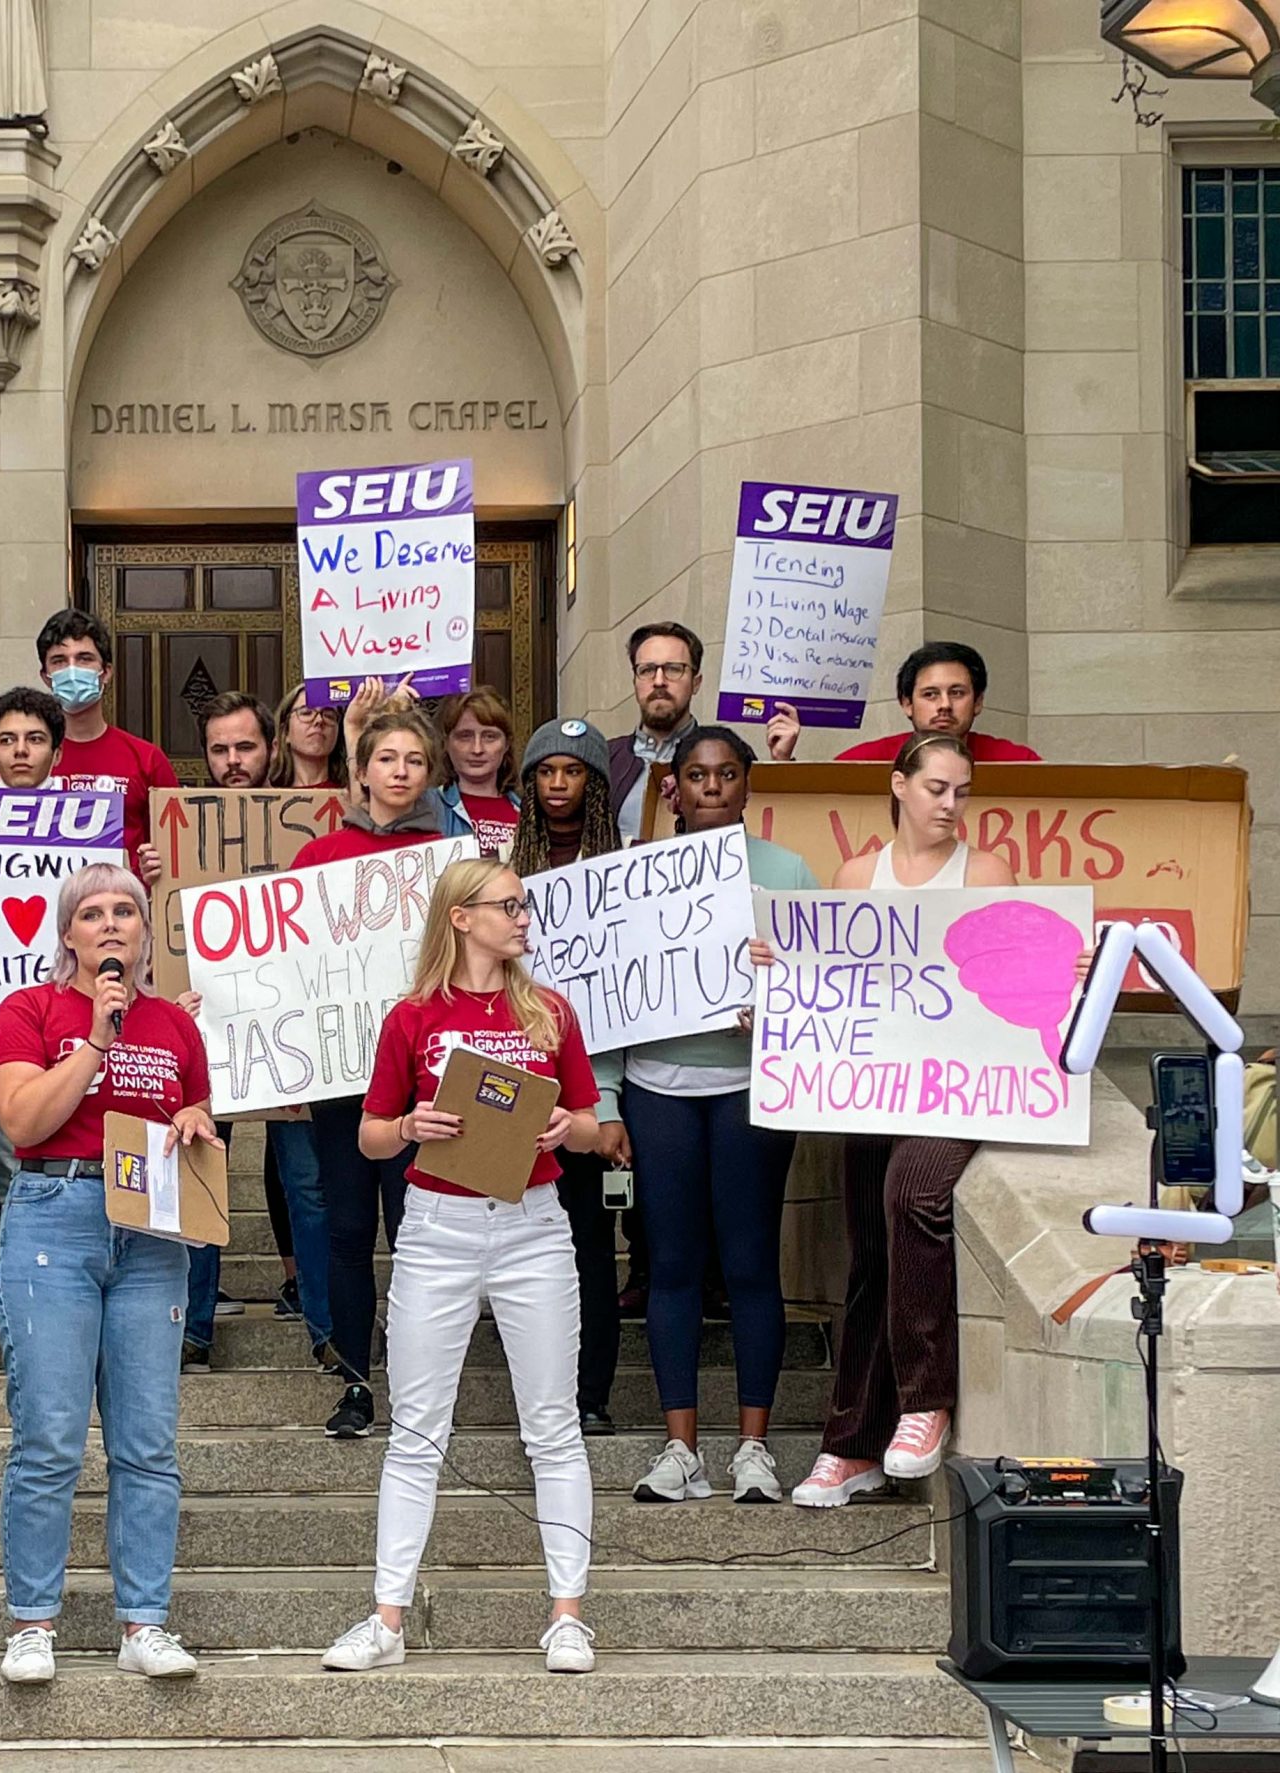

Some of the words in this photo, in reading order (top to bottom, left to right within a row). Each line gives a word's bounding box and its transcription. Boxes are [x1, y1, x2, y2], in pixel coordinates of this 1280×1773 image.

[90, 402, 216, 434] DANIEL
[230, 402, 258, 433] L.
[267, 401, 394, 434] MARSH
[408, 400, 548, 433] CHAPEL
[313, 465, 460, 520] SEIU
[753, 489, 888, 540] SEIU
[302, 533, 363, 574] We
[375, 529, 476, 571] Deserve
[744, 540, 845, 587] Trending
[310, 588, 339, 612] A
[355, 582, 442, 614] Living
[746, 590, 764, 608] 1)
[770, 591, 826, 620] Living
[834, 598, 870, 625] Wage
[320, 620, 432, 659] Wage!
[740, 617, 763, 636] 2)
[769, 617, 825, 643] Dental
[738, 641, 759, 657] 3)
[764, 643, 799, 664] Visa
[731, 663, 752, 681] 4)
[760, 665, 816, 689] Summer
[71, 781, 128, 795] GRATE
[828, 807, 1125, 881] WRKS
[527, 876, 572, 936] NO
[584, 831, 743, 920] DECISIONS
[193, 877, 309, 962] OUR
[531, 919, 627, 981] ABOUT
[659, 894, 715, 941] US
[771, 899, 920, 958] UNION
[213, 962, 282, 1018] IS
[295, 945, 374, 1001] WHY
[694, 937, 754, 1006] US
[765, 962, 953, 1020] BUSTERS
[491, 1050, 548, 1063] ORKERS
[760, 1016, 879, 1057] HAVE
[109, 1062, 178, 1082] WORKERS
[111, 1075, 164, 1091] UNION
[759, 1055, 910, 1114] SMOOTH
[478, 1088, 515, 1105] SEIU
[130, 1156, 141, 1191] SEIU
[1050, 1472, 1091, 1482] SPORT
